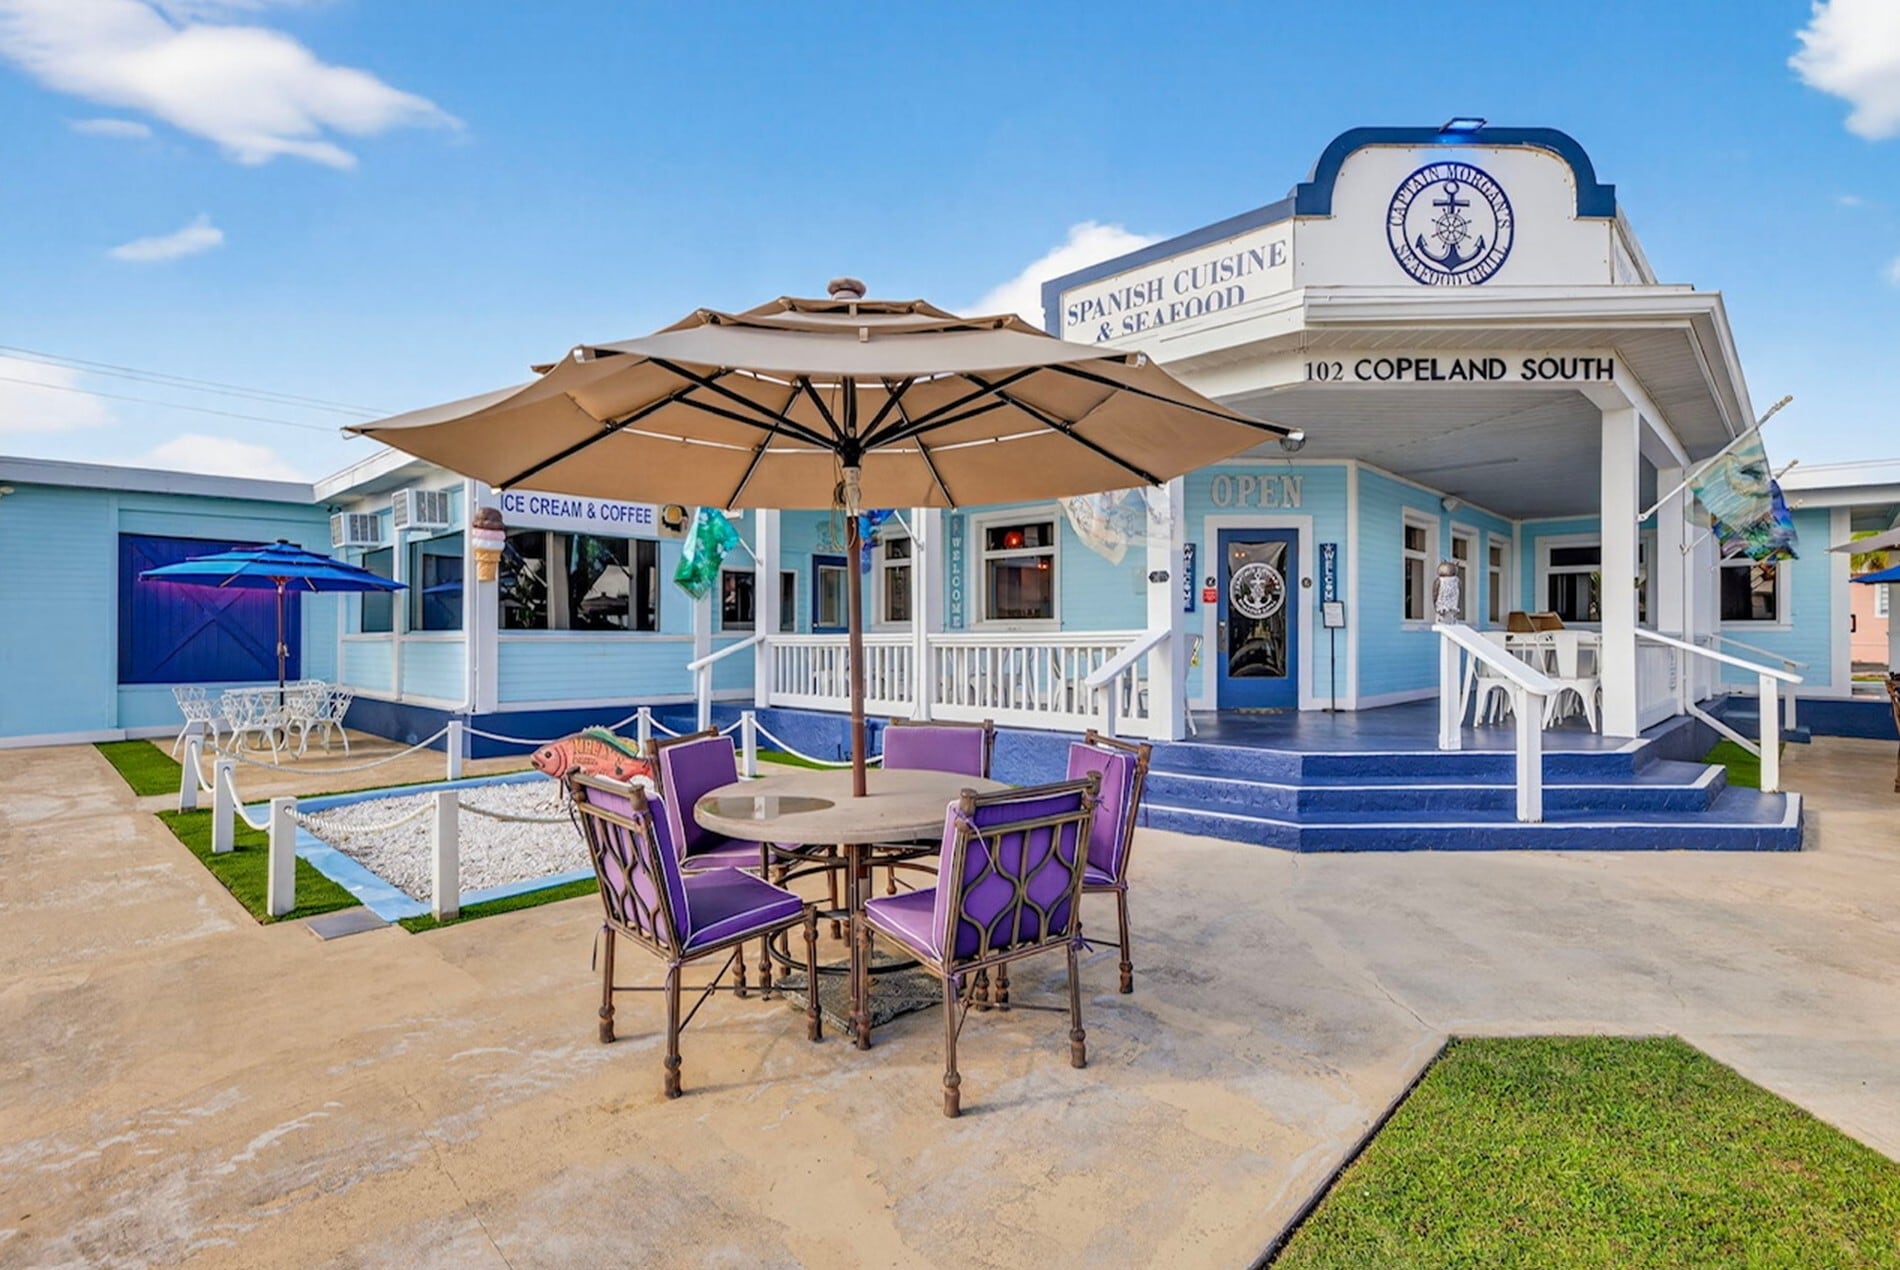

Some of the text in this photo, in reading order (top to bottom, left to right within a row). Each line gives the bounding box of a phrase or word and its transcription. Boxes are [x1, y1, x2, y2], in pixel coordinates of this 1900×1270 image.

[1389, 164, 1511, 229] CAPTAIN MORGAN'S
[1067, 240, 1288, 327] SPANISH CUISINE
[1096, 285, 1246, 343] & SEAFOOD
[1304, 357, 1614, 382] 102 COPELAND SOUTH
[500, 494, 652, 525] ICE CREAM & COFFEE
[1211, 475, 1304, 508] OPEN
[951, 537, 962, 628] WELCOME
